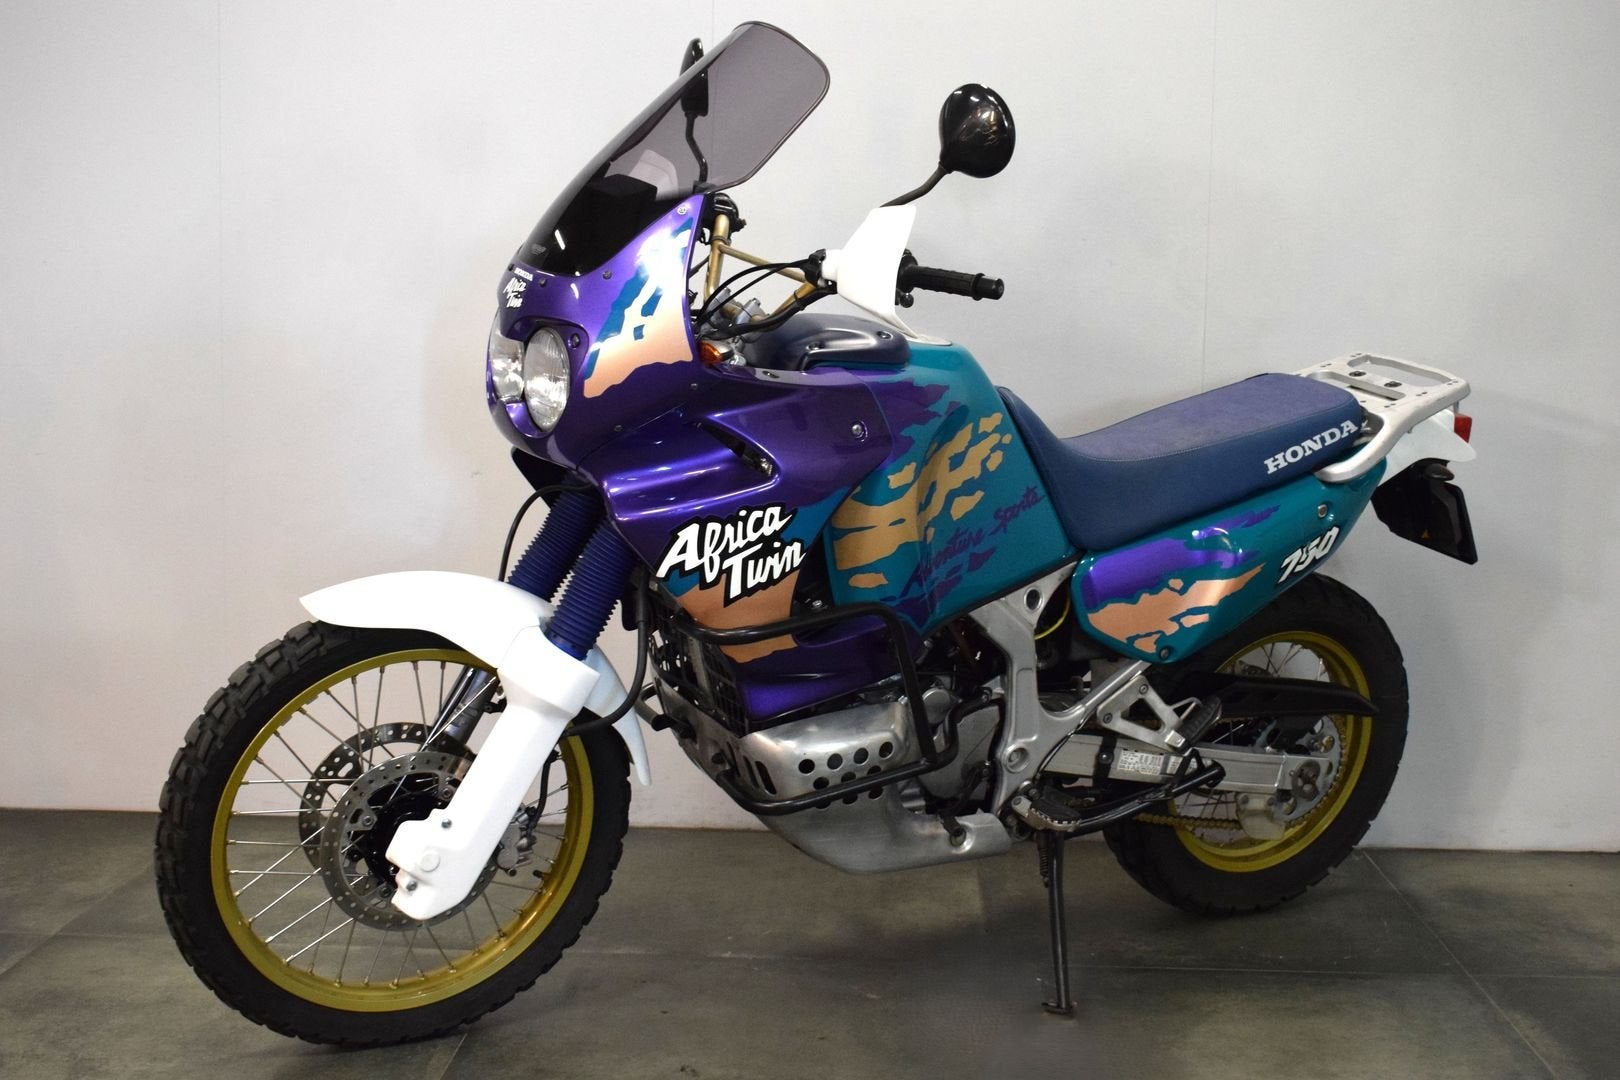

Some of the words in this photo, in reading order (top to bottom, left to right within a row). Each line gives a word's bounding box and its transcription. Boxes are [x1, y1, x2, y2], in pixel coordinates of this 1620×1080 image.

[1263, 419, 1359, 474] HONDA
[655, 506, 793, 584] Africa
[722, 541, 807, 599] Twin
[899, 527, 985, 598] Aenture
[1277, 526, 1340, 583] 750
